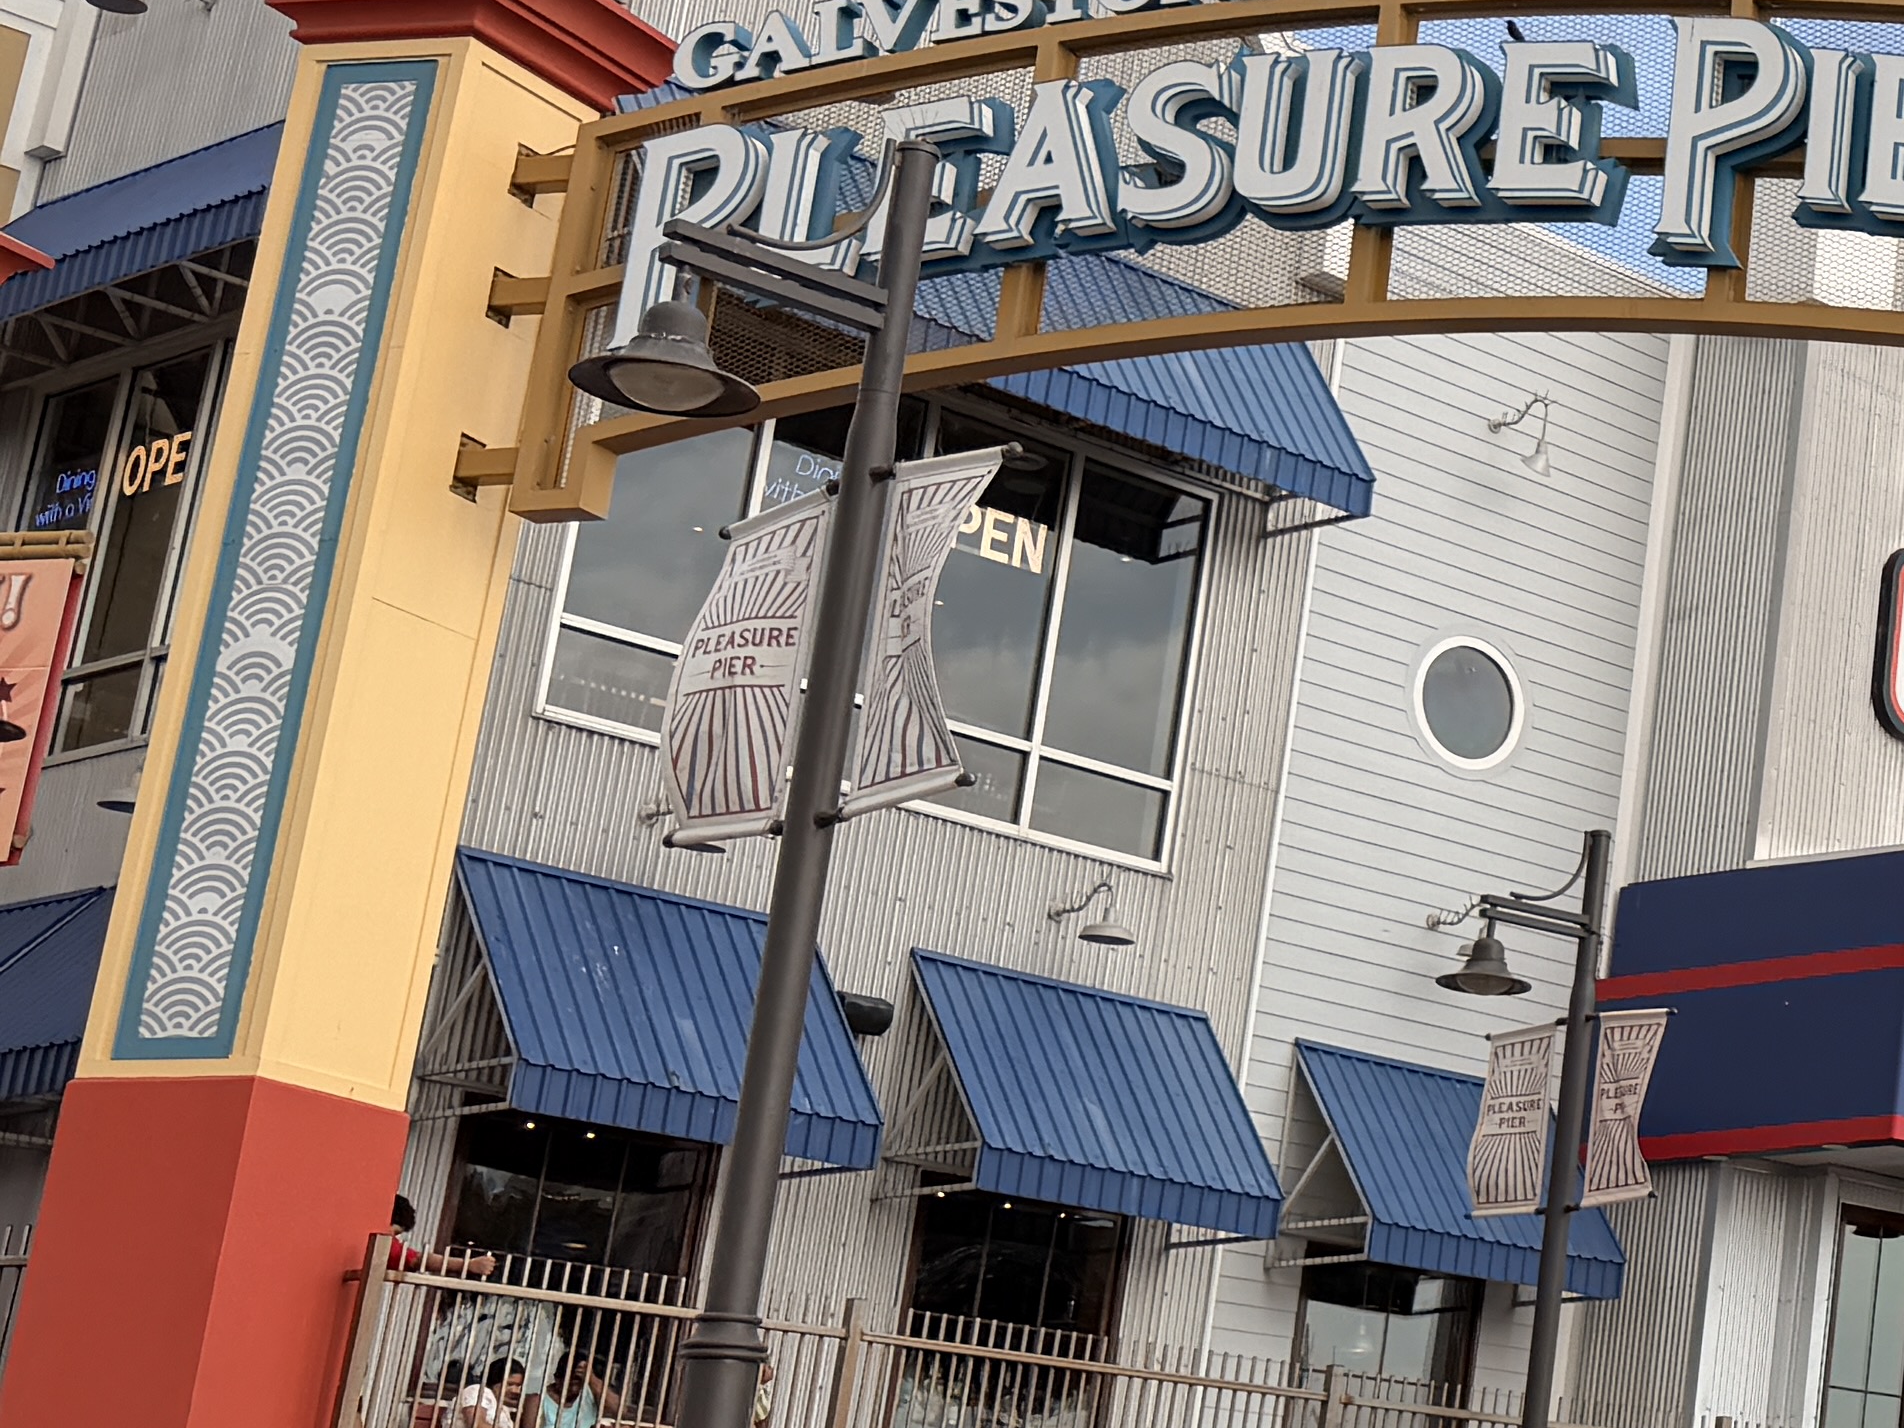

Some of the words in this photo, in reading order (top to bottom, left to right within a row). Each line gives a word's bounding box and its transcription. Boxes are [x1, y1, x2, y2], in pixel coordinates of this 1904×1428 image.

[608, 40, 1638, 353] PLEASURE
[122, 431, 193, 496] OPE
[950, 503, 1048, 574] PEN
[691, 626, 799, 659] PLEASURE
[710, 656, 758, 680] PIER
[1487, 1098, 1542, 1115] PLEASURE
[1499, 1117, 1526, 1129] PIER
